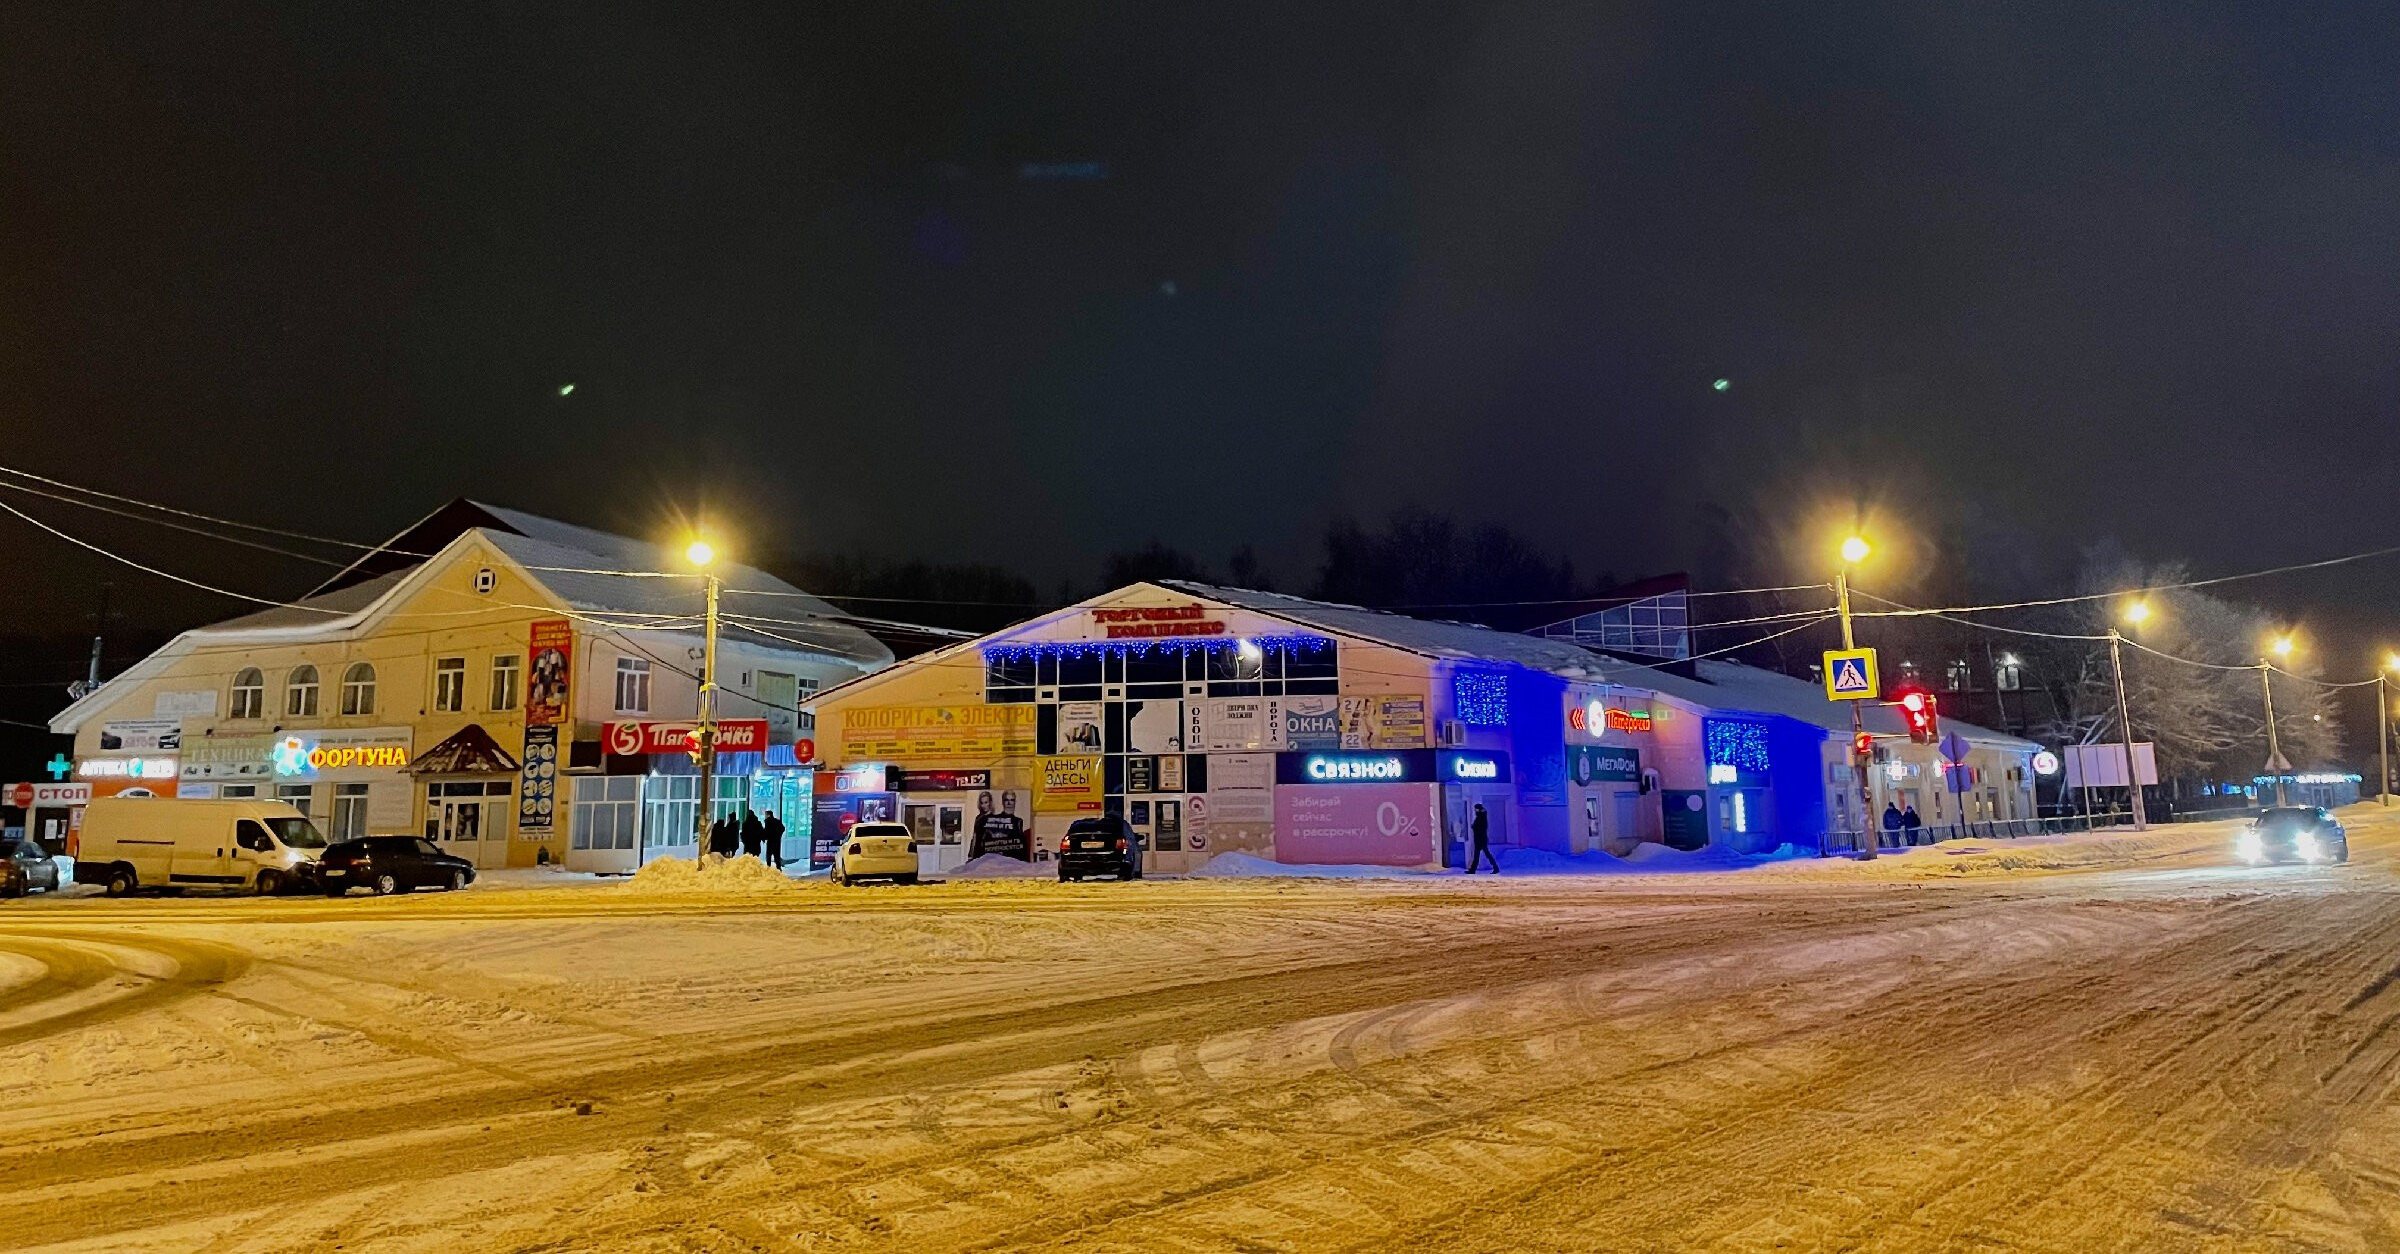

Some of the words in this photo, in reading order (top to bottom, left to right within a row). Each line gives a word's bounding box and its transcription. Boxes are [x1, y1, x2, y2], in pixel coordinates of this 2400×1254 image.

[1107, 621, 1225, 638] КОМПЛЕКС
[845, 708, 921, 728] КОЛОРИТ
[960, 706, 1036, 725] ЭЛЕКТРО
[1286, 718, 1336, 732] ОКНА
[308, 747, 407, 768] ФОРТУНА
[1045, 759, 1090, 773] ДЕНЬГИ
[1309, 757, 1402, 778] Связной
[955, 774, 986, 787] TELE2
[39, 788, 87, 800] СТОП
[1291, 796, 1340, 808] Забирай
[1293, 811, 1332, 822] сейчас
[1377, 801, 1420, 837] 0%
[1303, 828, 1368, 838] рассрочку!
